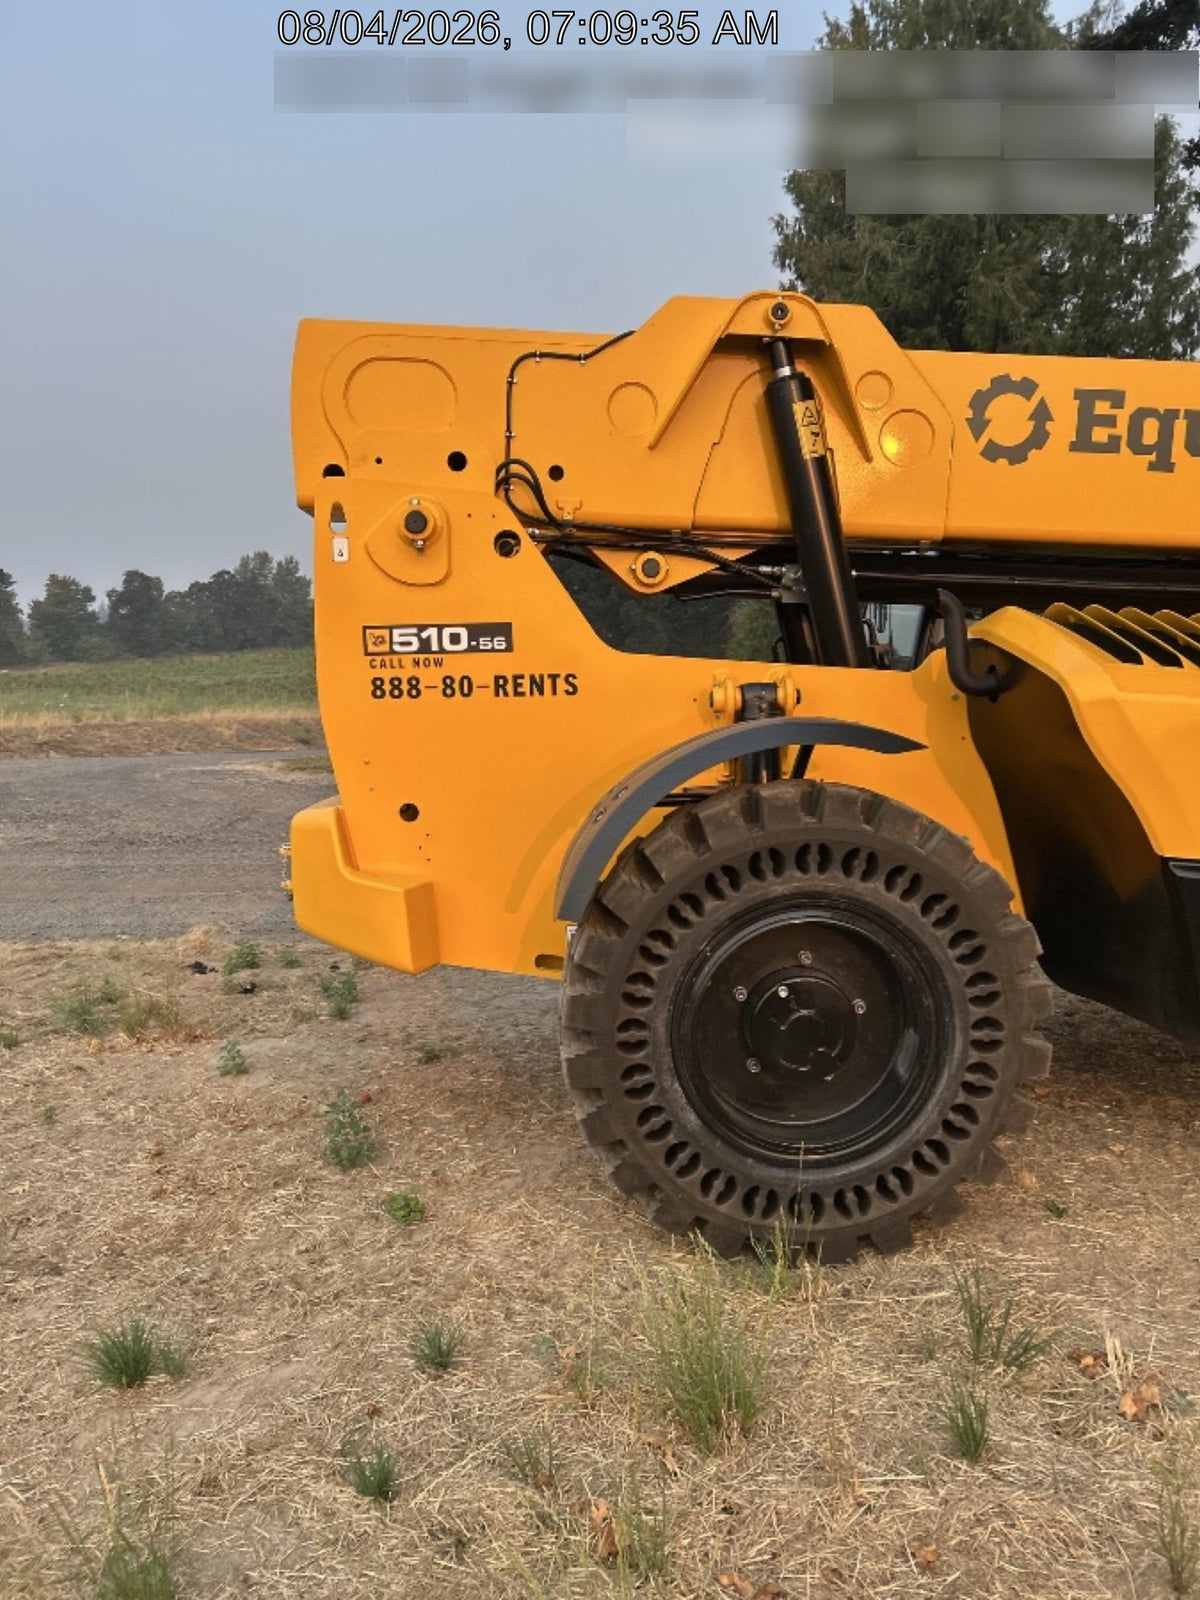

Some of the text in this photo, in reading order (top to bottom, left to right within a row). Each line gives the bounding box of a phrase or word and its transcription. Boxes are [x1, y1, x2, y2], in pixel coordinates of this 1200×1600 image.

[369, 657, 444, 670] CALL NOW
[370, 673, 579, 700] 888-80-RENTS
